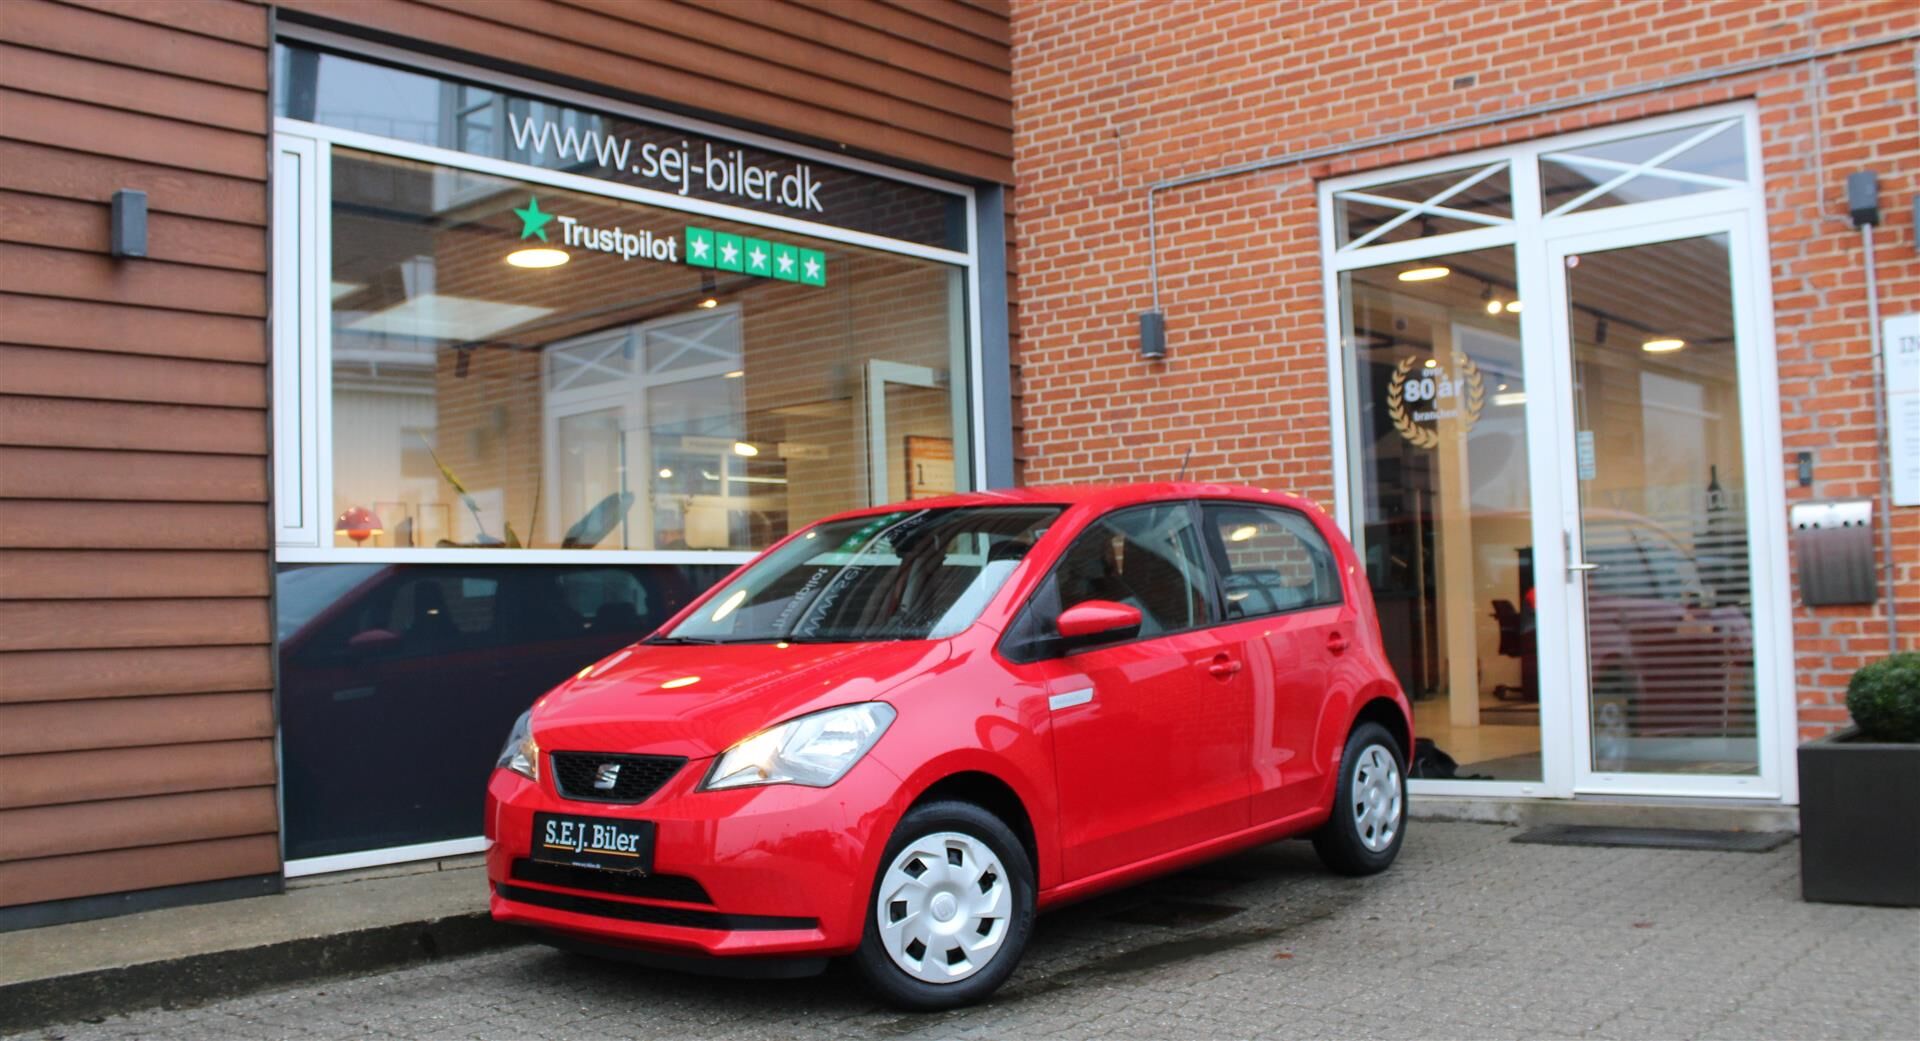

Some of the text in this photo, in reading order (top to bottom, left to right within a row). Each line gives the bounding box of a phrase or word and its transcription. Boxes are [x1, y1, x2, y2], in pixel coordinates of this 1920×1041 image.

[508, 112, 824, 213] www.sej-biler.dk
[557, 215, 678, 263] Trustpilot
[1404, 379, 1435, 402] 80
[545, 820, 640, 853] S.E.J. Biler
